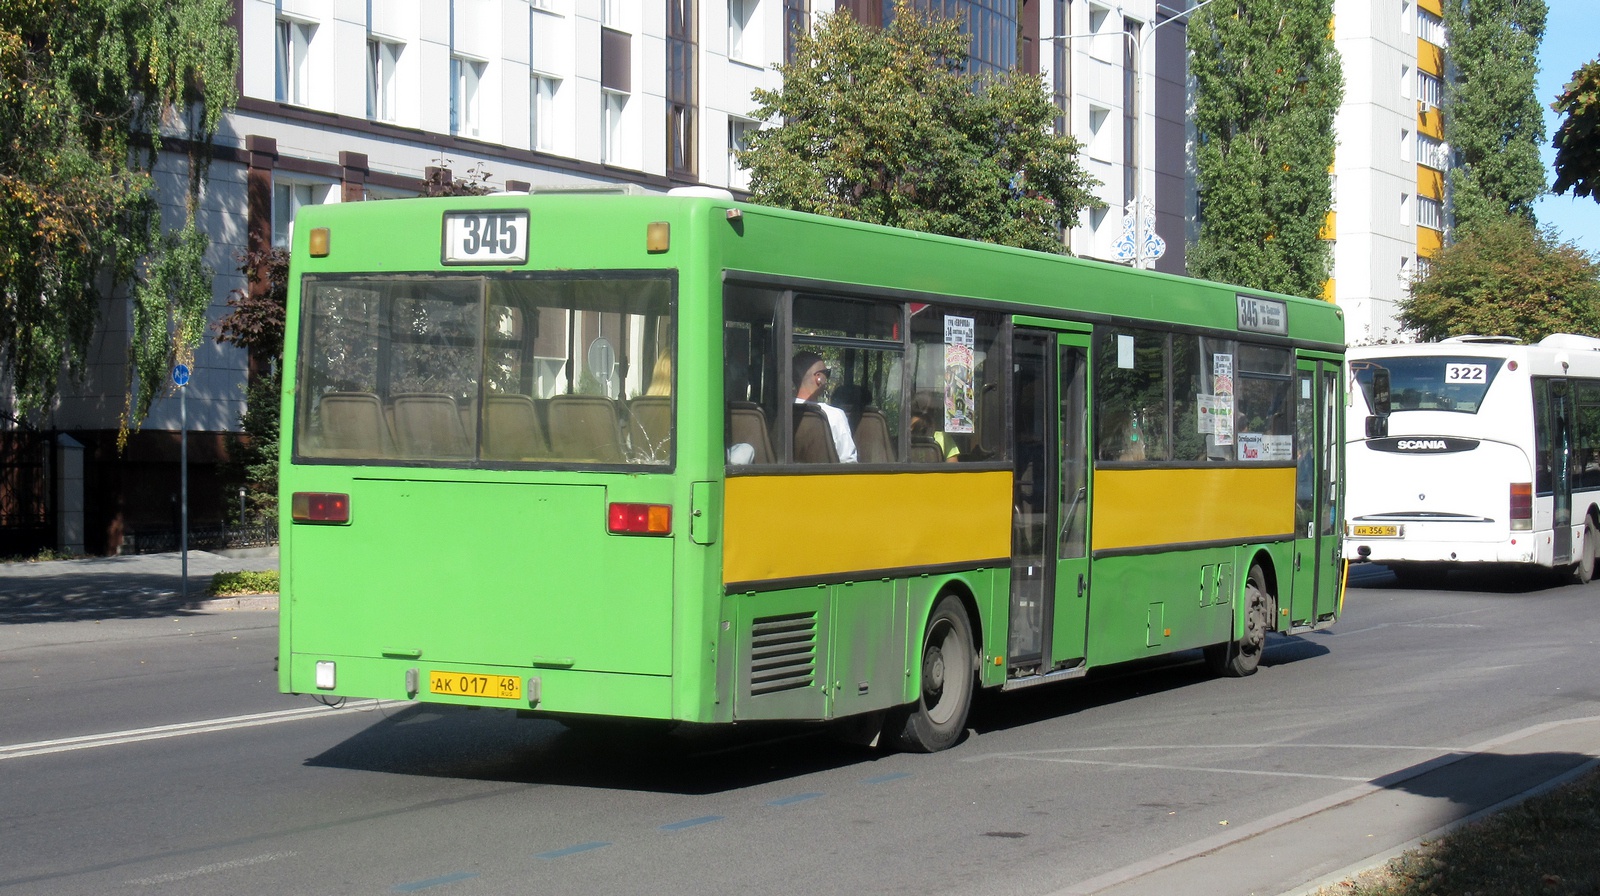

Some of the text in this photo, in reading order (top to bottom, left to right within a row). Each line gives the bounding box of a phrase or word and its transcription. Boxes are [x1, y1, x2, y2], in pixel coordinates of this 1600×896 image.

[463, 214, 517, 255] 345
[1241, 299, 1258, 328] 345
[1450, 368, 1483, 380] 322
[1397, 440, 1447, 450] SCANIA
[1369, 526, 1383, 535] 356
[460, 676, 488, 694] 017
[500, 678, 515, 691] 48
